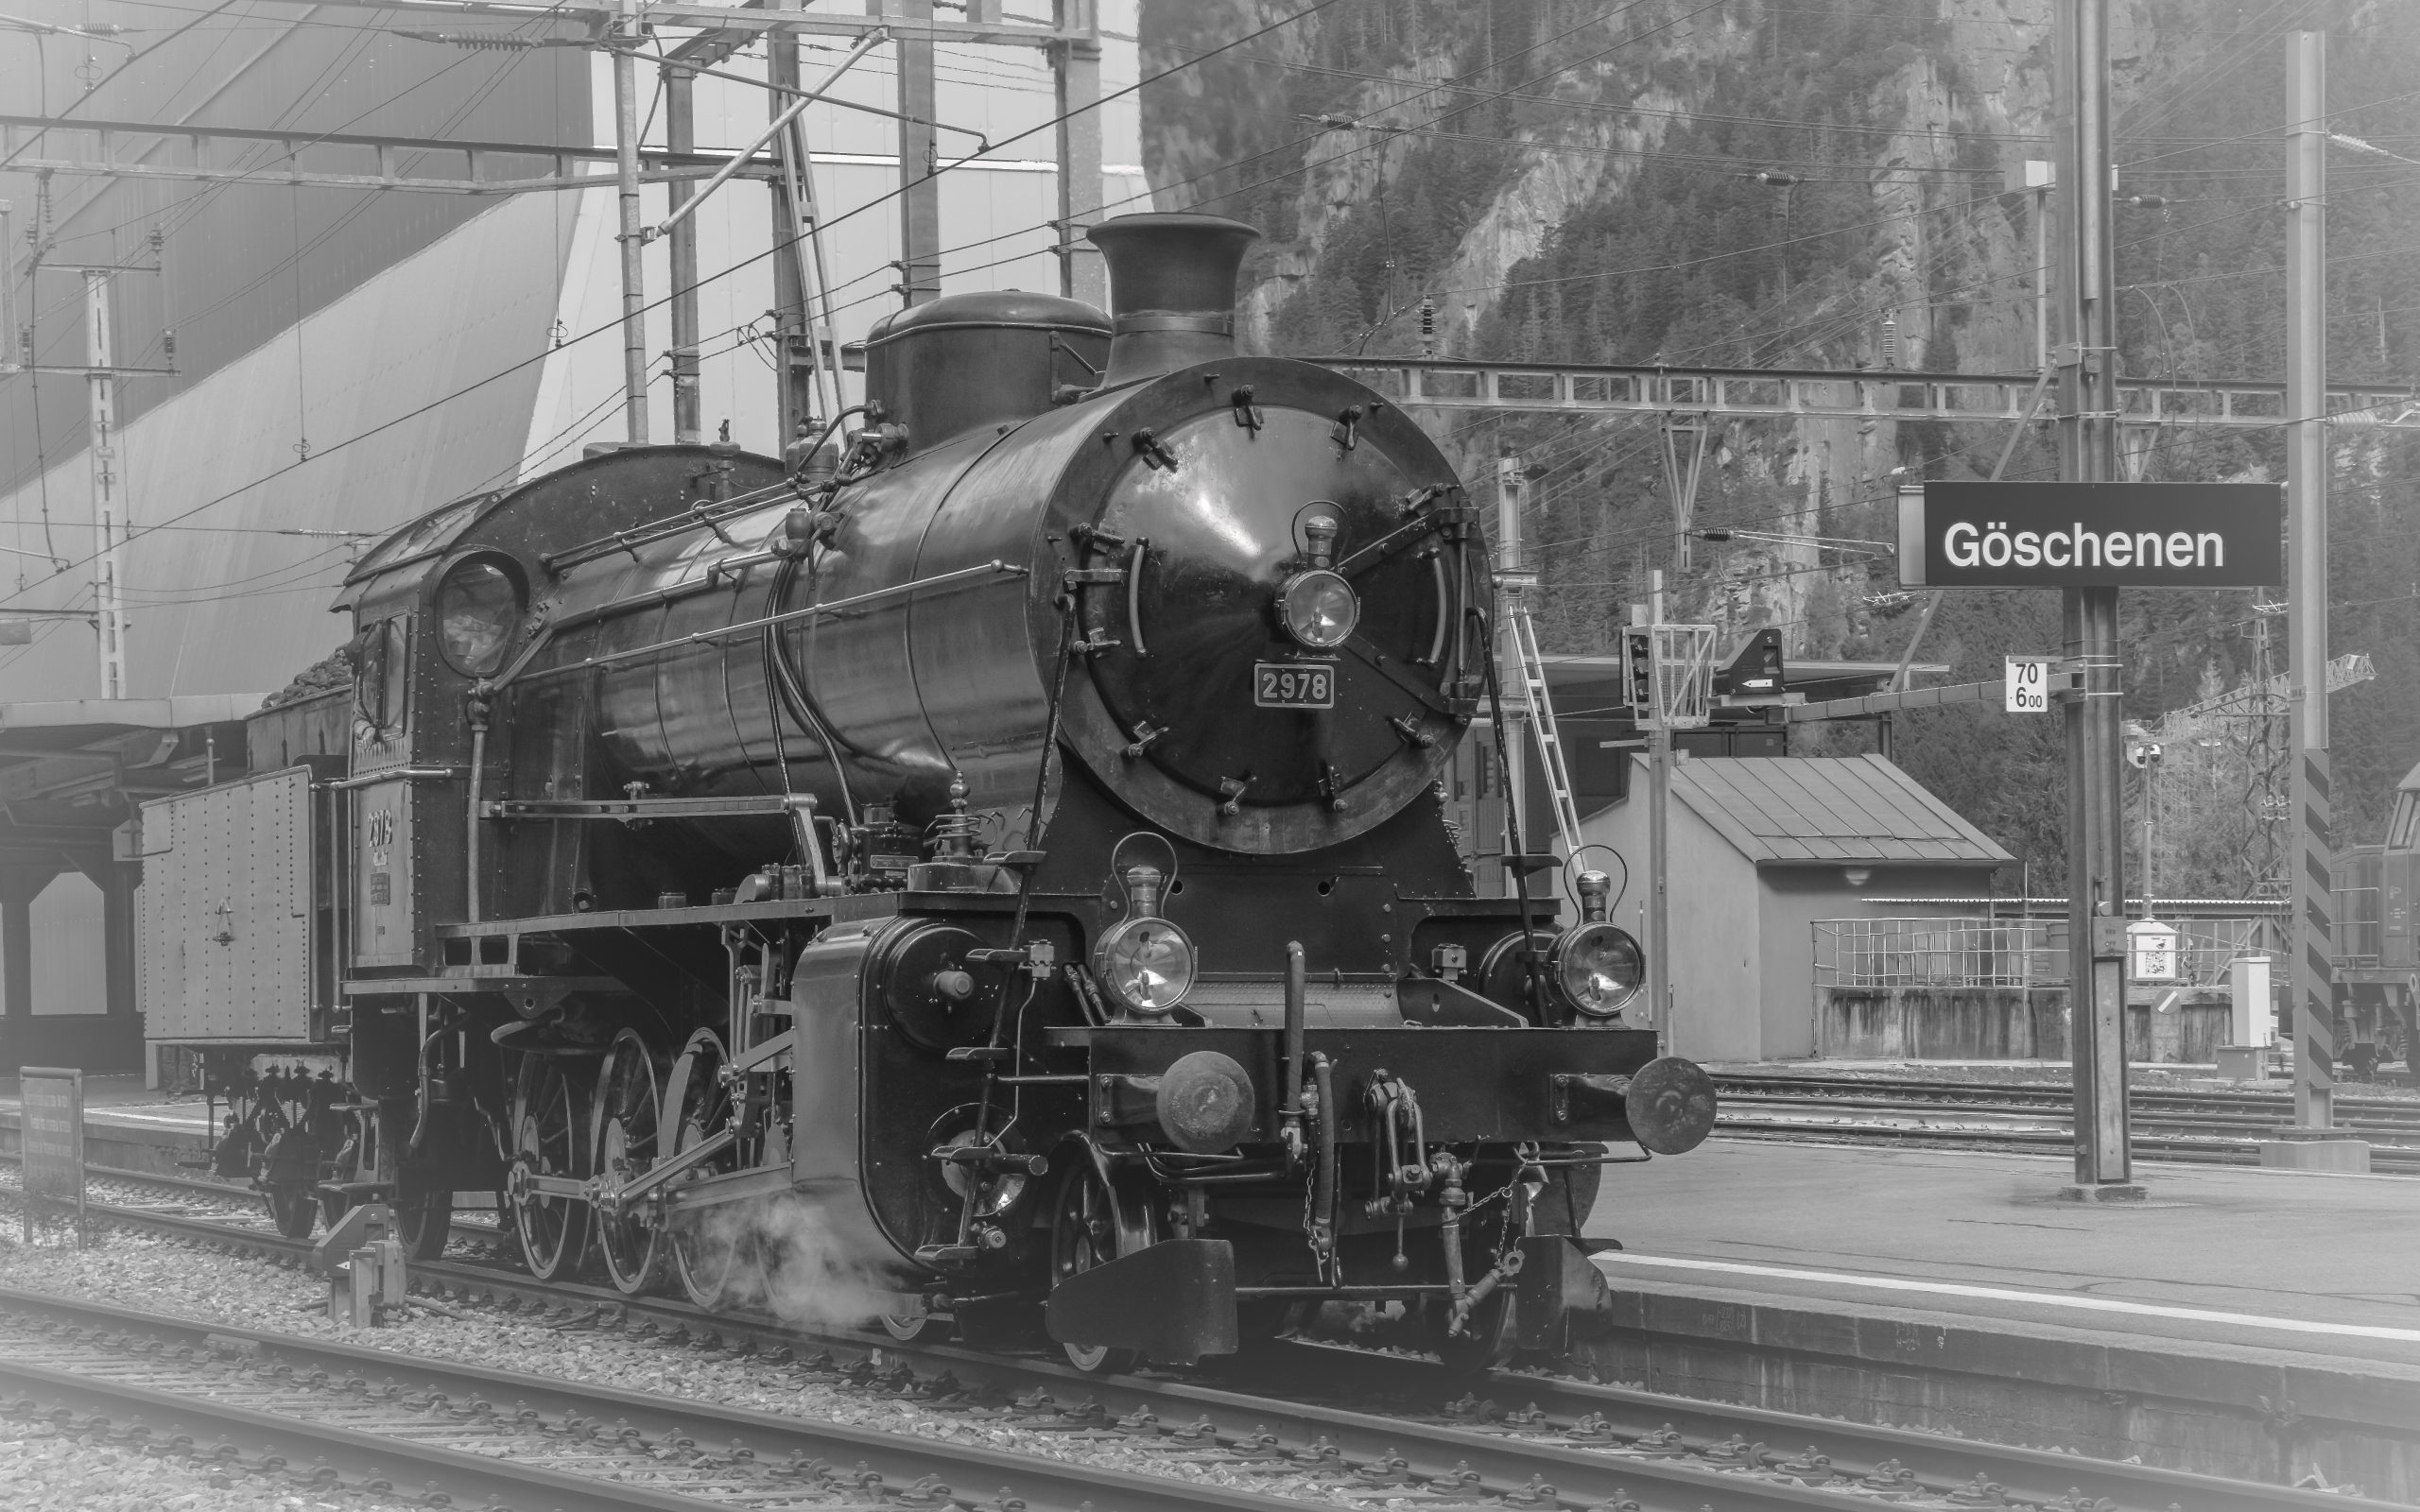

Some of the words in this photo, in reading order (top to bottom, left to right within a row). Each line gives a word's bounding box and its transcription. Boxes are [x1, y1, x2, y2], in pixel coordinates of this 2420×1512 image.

[1944, 522, 2224, 568] Göschenen
[1262, 673, 1327, 700] 2978
[2015, 662, 2038, 684] 70
